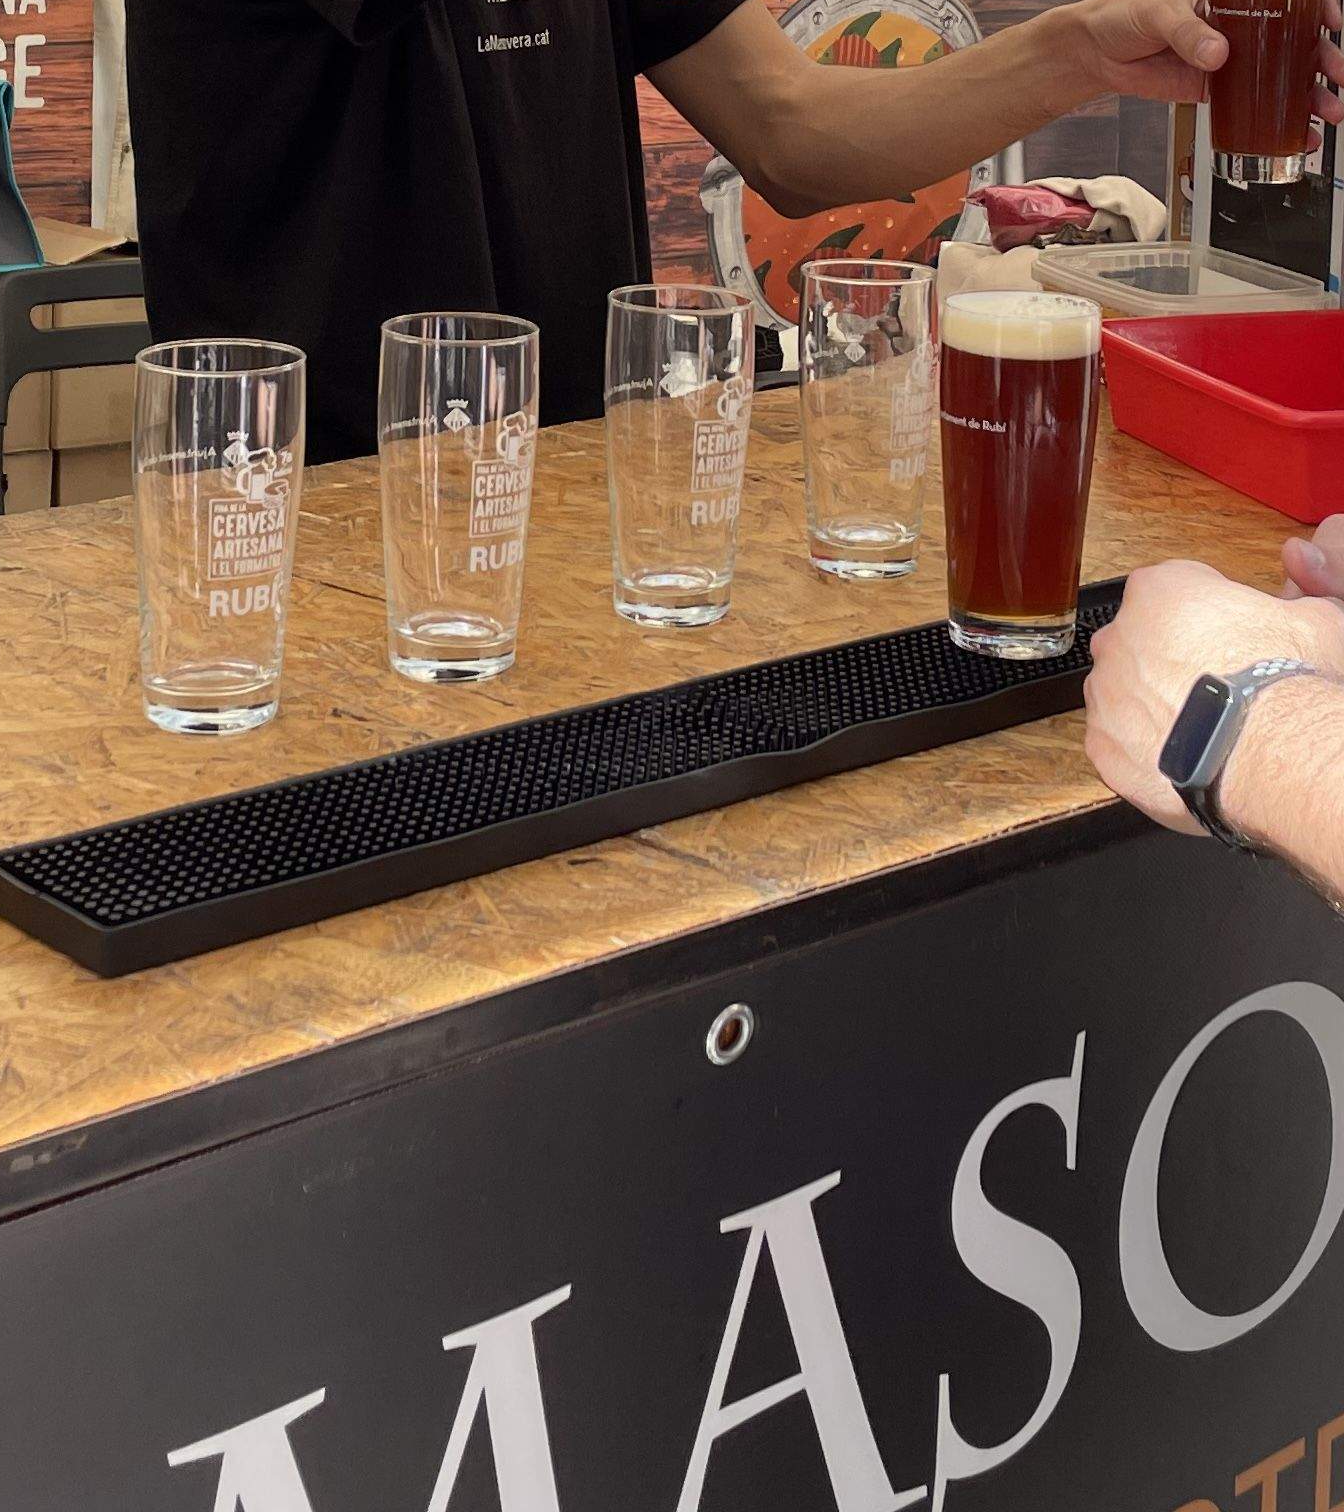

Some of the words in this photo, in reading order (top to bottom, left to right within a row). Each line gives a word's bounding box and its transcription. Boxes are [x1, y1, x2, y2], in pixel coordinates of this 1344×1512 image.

[982, 419, 1007, 433] Rubí
[212, 508, 286, 539] CERVESA
[212, 531, 284, 560] ARTESANA
